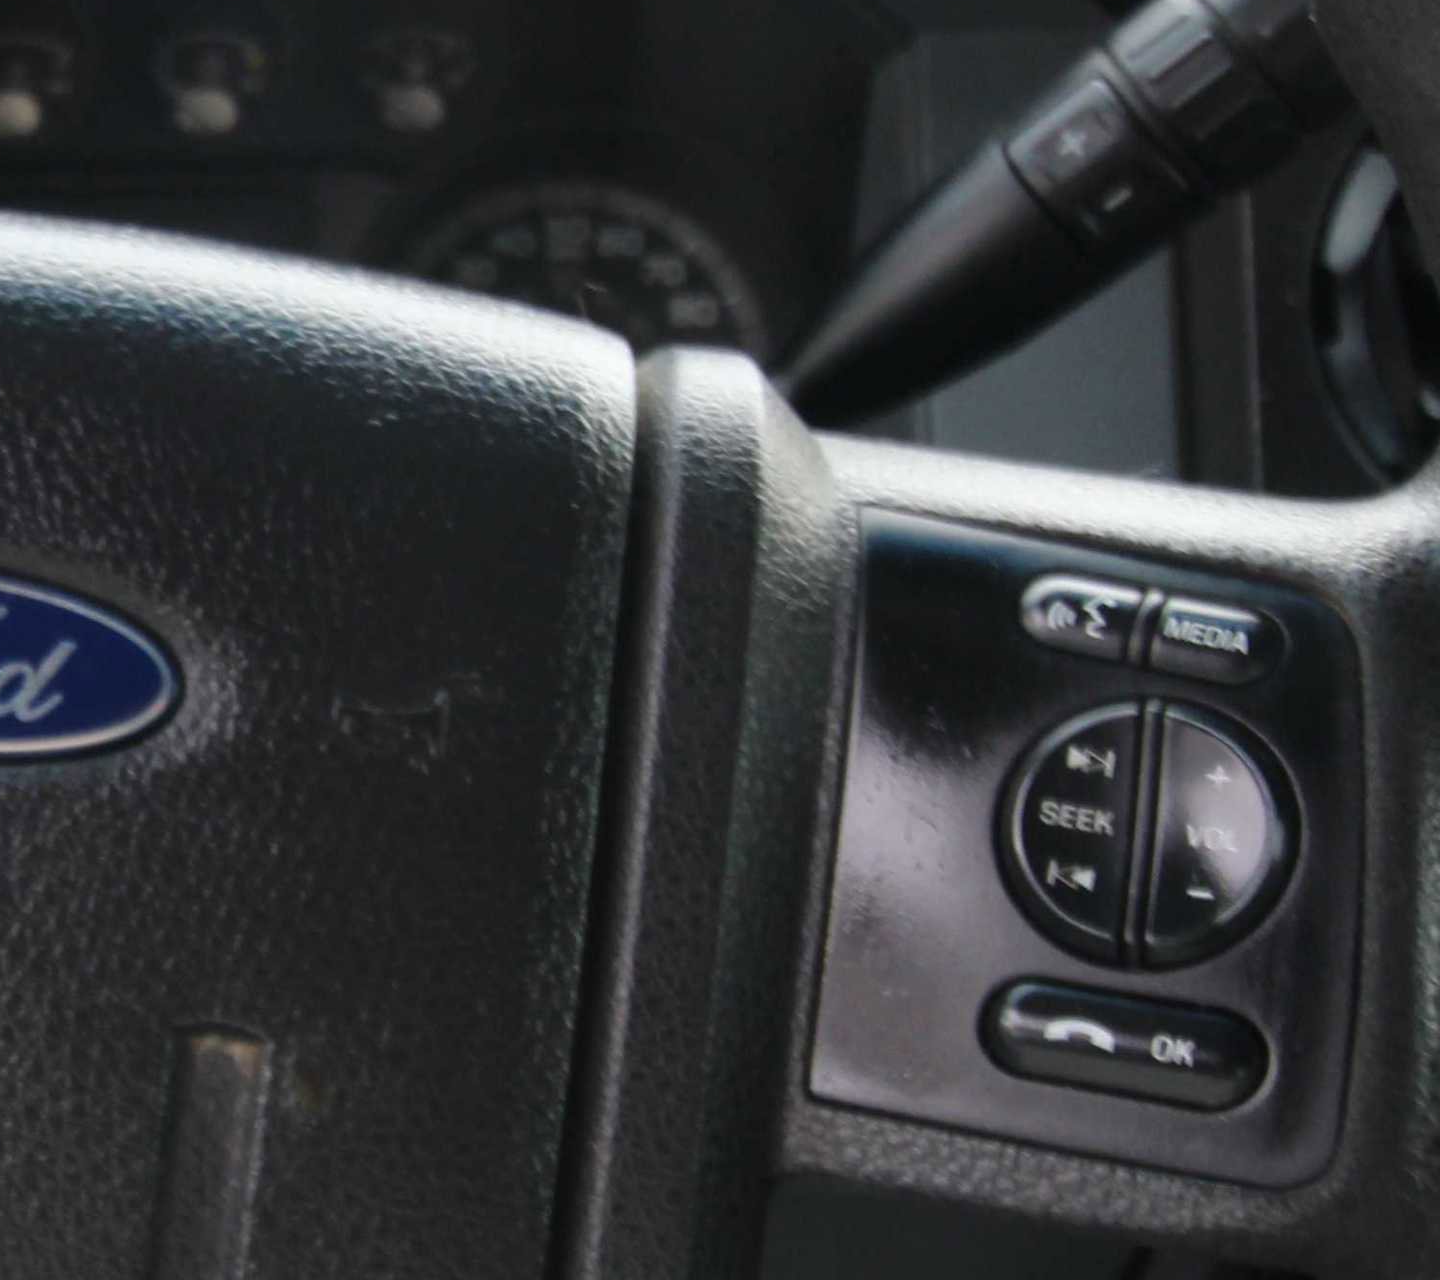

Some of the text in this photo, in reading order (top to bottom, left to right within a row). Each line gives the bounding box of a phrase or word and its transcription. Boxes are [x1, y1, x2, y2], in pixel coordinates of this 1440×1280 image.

[1162, 616, 1250, 656] MEDIA
[1038, 800, 1115, 837] SEEK
[1185, 823, 1240, 854] VOL
[1149, 1035, 1196, 1067] OK
